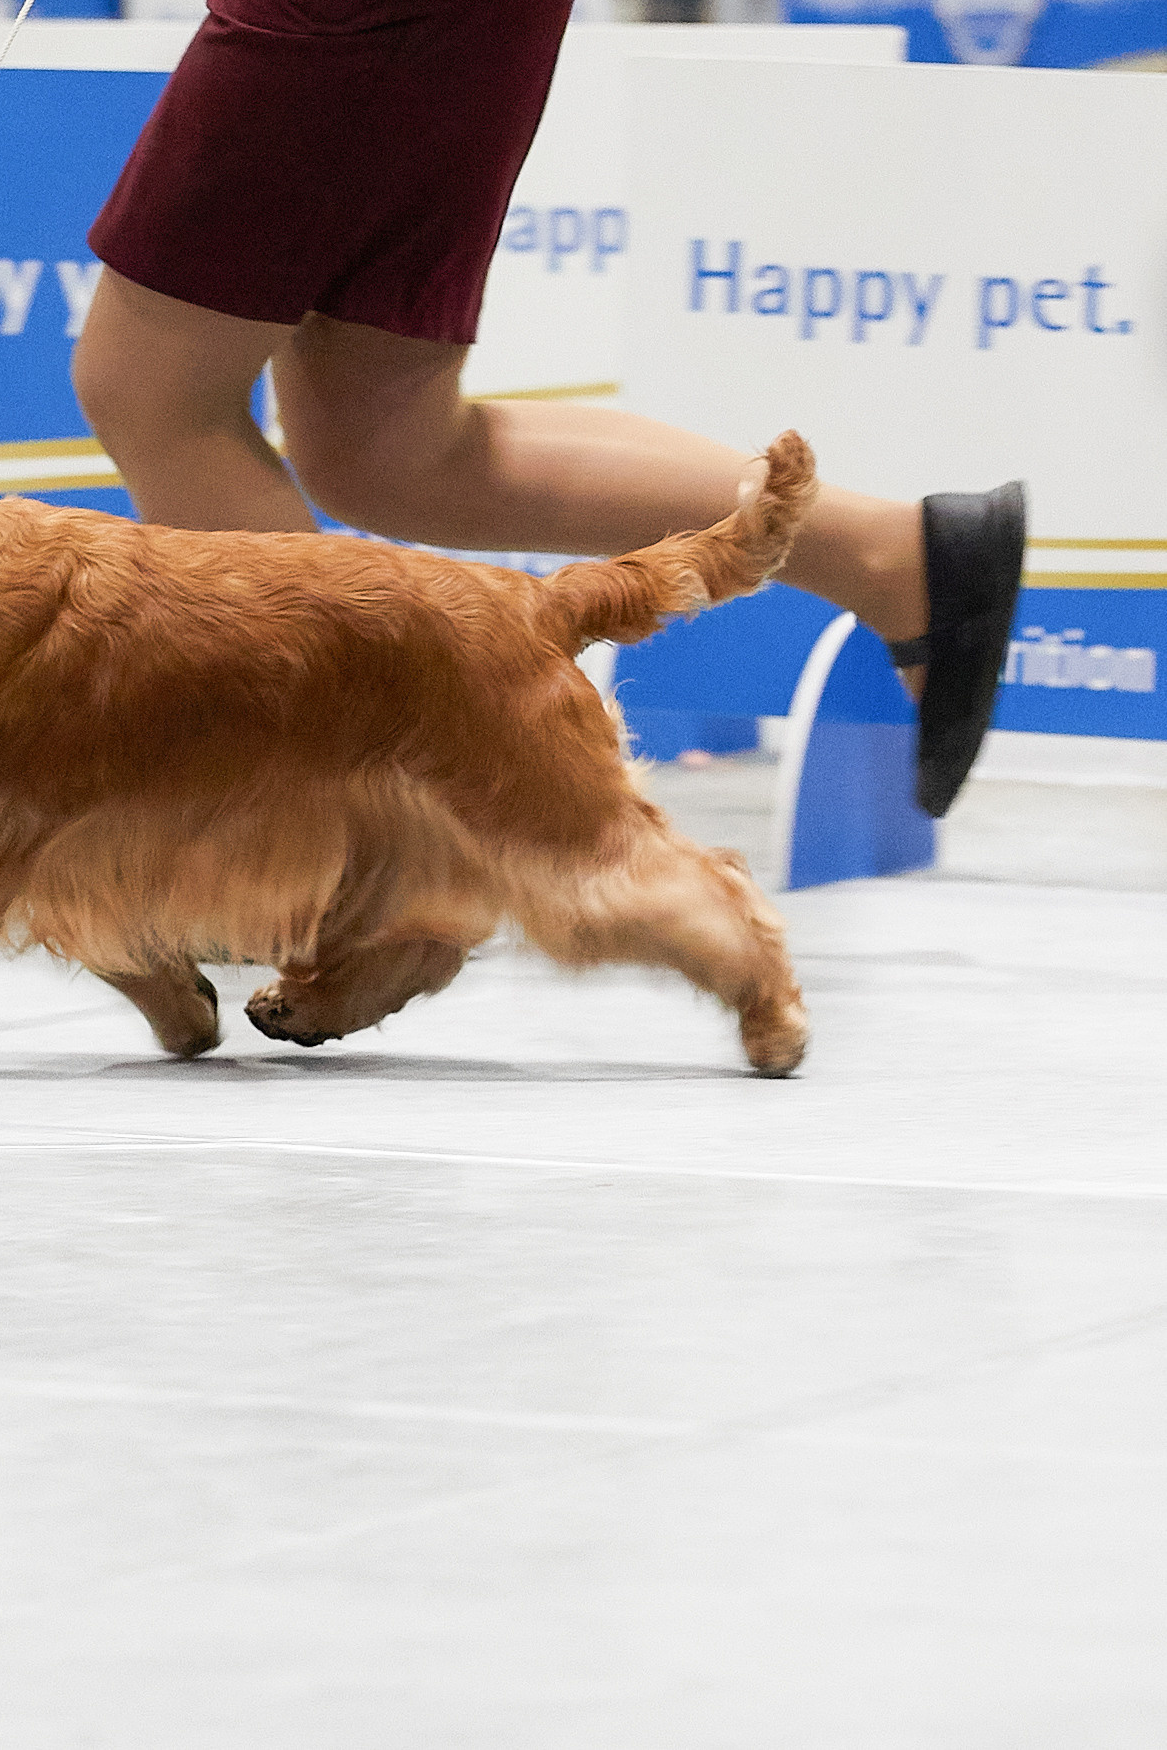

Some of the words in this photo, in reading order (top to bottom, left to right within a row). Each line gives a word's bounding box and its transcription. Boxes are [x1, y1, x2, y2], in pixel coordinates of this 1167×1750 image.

[503, 205, 631, 274] app
[686, 238, 943, 347] Happy
[974, 265, 1134, 350] pet.
